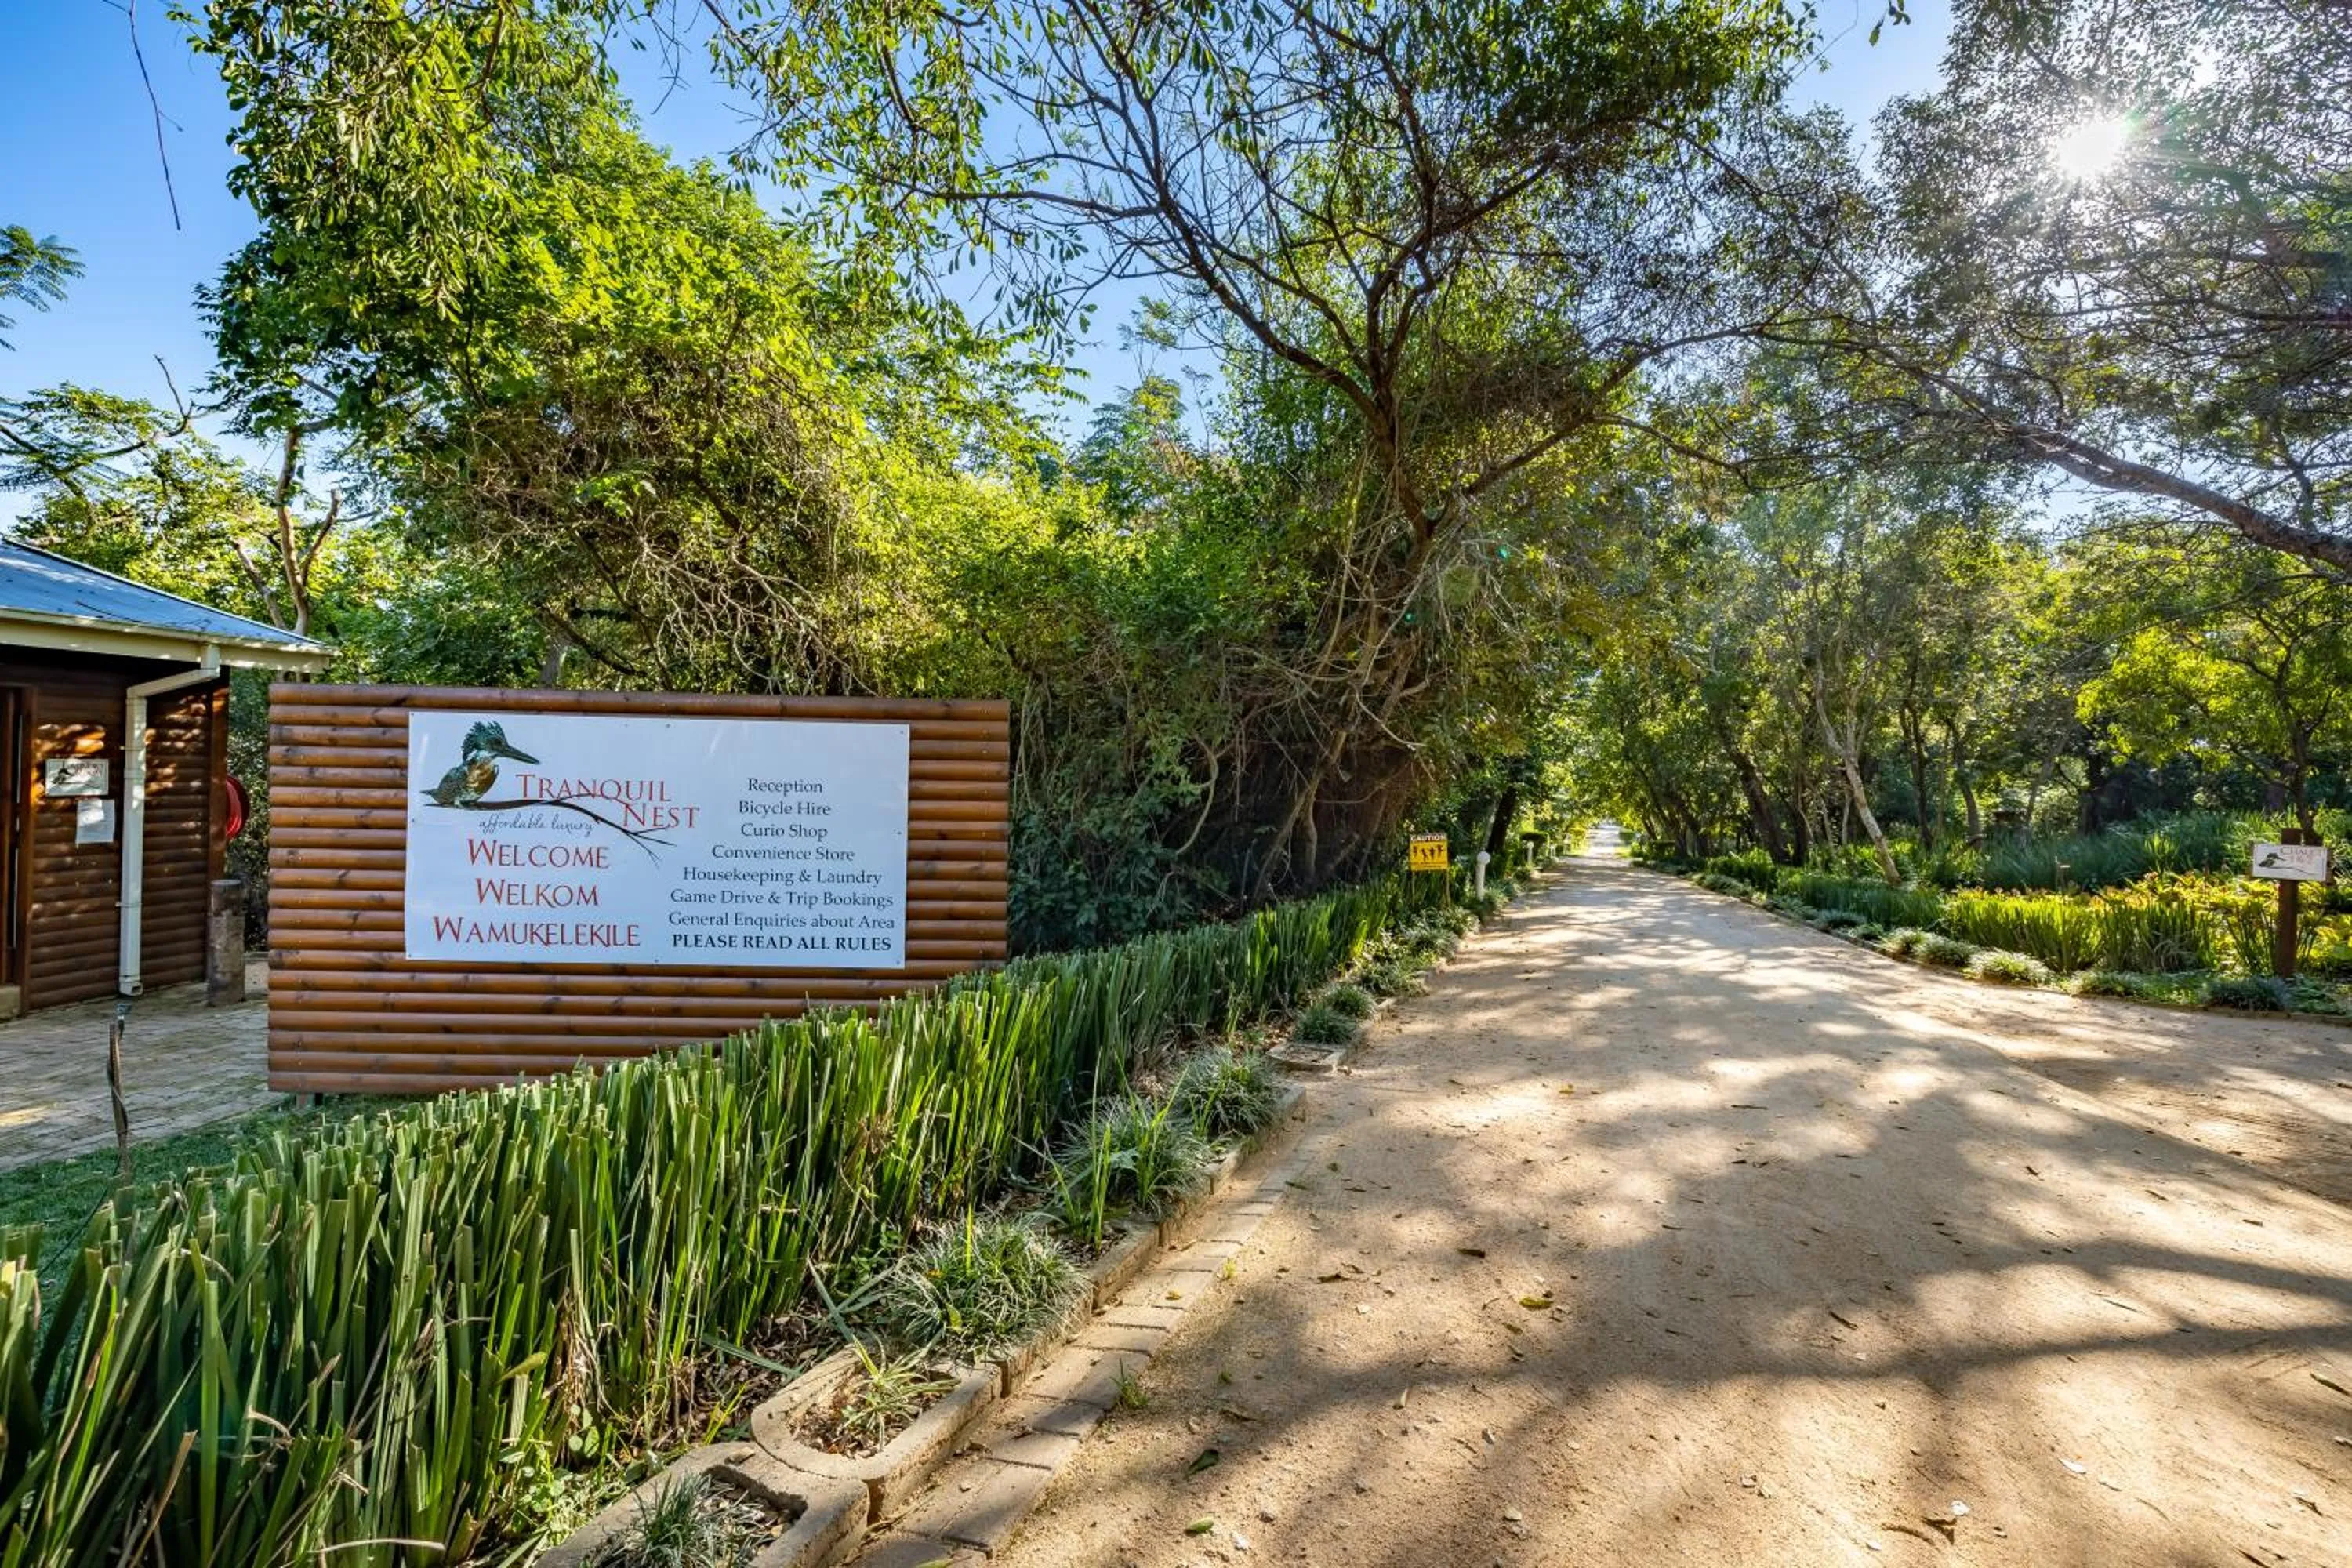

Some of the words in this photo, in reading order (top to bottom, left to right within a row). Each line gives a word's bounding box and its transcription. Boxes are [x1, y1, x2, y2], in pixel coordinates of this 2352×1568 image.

[516, 774, 672, 802] TRANQUIL
[748, 778, 822, 796] Reception
[623, 802, 699, 828] NEST
[739, 800, 792, 818] Bicycle
[797, 803, 831, 815] Hire
[478, 810, 546, 834] affordable
[551, 814, 593, 837] luxury
[741, 822, 784, 837] Curio
[789, 824, 828, 841] Shop
[467, 838, 609, 869] WELCOME
[712, 844, 811, 860] Convenience
[816, 846, 855, 861] Store
[683, 866, 794, 886] Housekeeping
[798, 869, 811, 882] &
[817, 869, 882, 887] Laundry
[476, 877, 600, 908] WELKOM
[670, 888, 716, 902] Game
[720, 890, 764, 904] Drive
[768, 891, 782, 904] &
[785, 891, 818, 909] Trip
[822, 892, 894, 909] Bookings
[668, 911, 728, 926] General
[734, 913, 807, 930] Enquiries
[811, 914, 854, 928] about
[858, 916, 895, 929] Area
[434, 916, 641, 947] WAMUKELEKILE
[672, 934, 738, 948] PLEASE
[744, 935, 792, 949] READ
[797, 936, 831, 950] ALL
[835, 937, 891, 951] RULES
